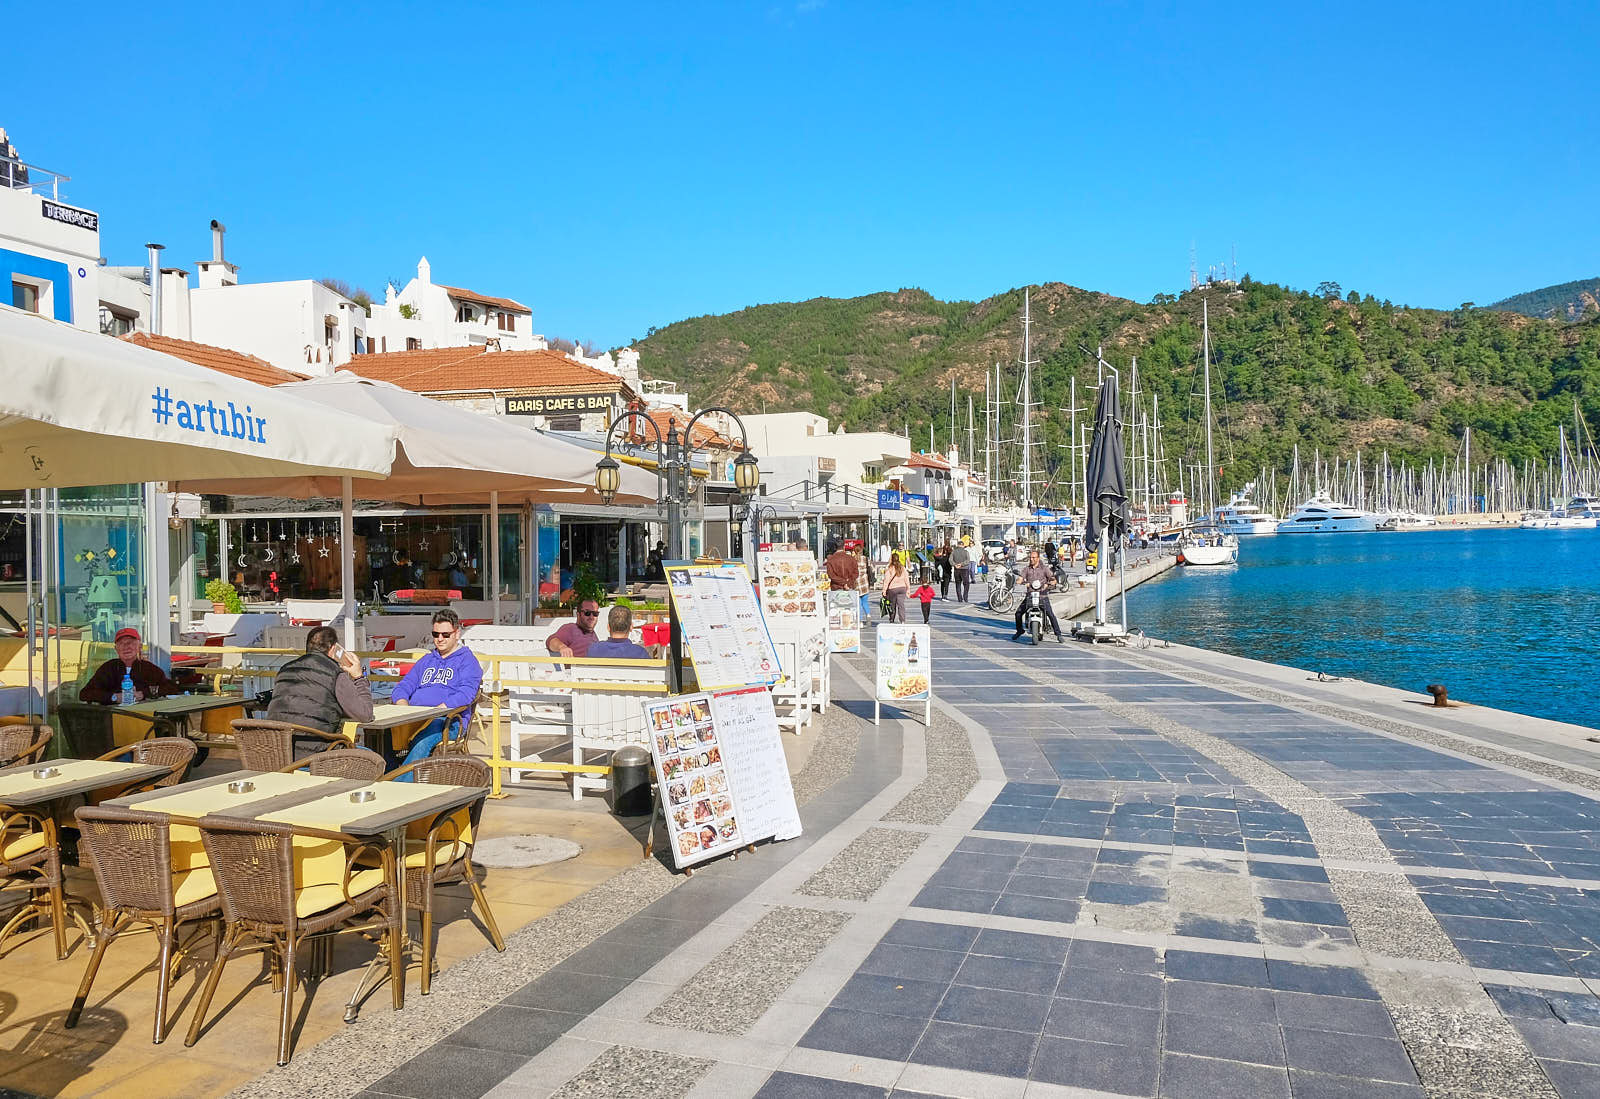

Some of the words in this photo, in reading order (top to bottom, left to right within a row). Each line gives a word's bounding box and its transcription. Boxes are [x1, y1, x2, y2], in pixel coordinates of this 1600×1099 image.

[45, 203, 97, 229] TERRACE
[151, 386, 267, 444] #artıbir
[508, 400, 544, 413] BARIŞ
[546, 398, 575, 411] CAFE
[577, 399, 586, 409] &
[587, 396, 612, 409] BAR
[420, 667, 454, 686] GAP
